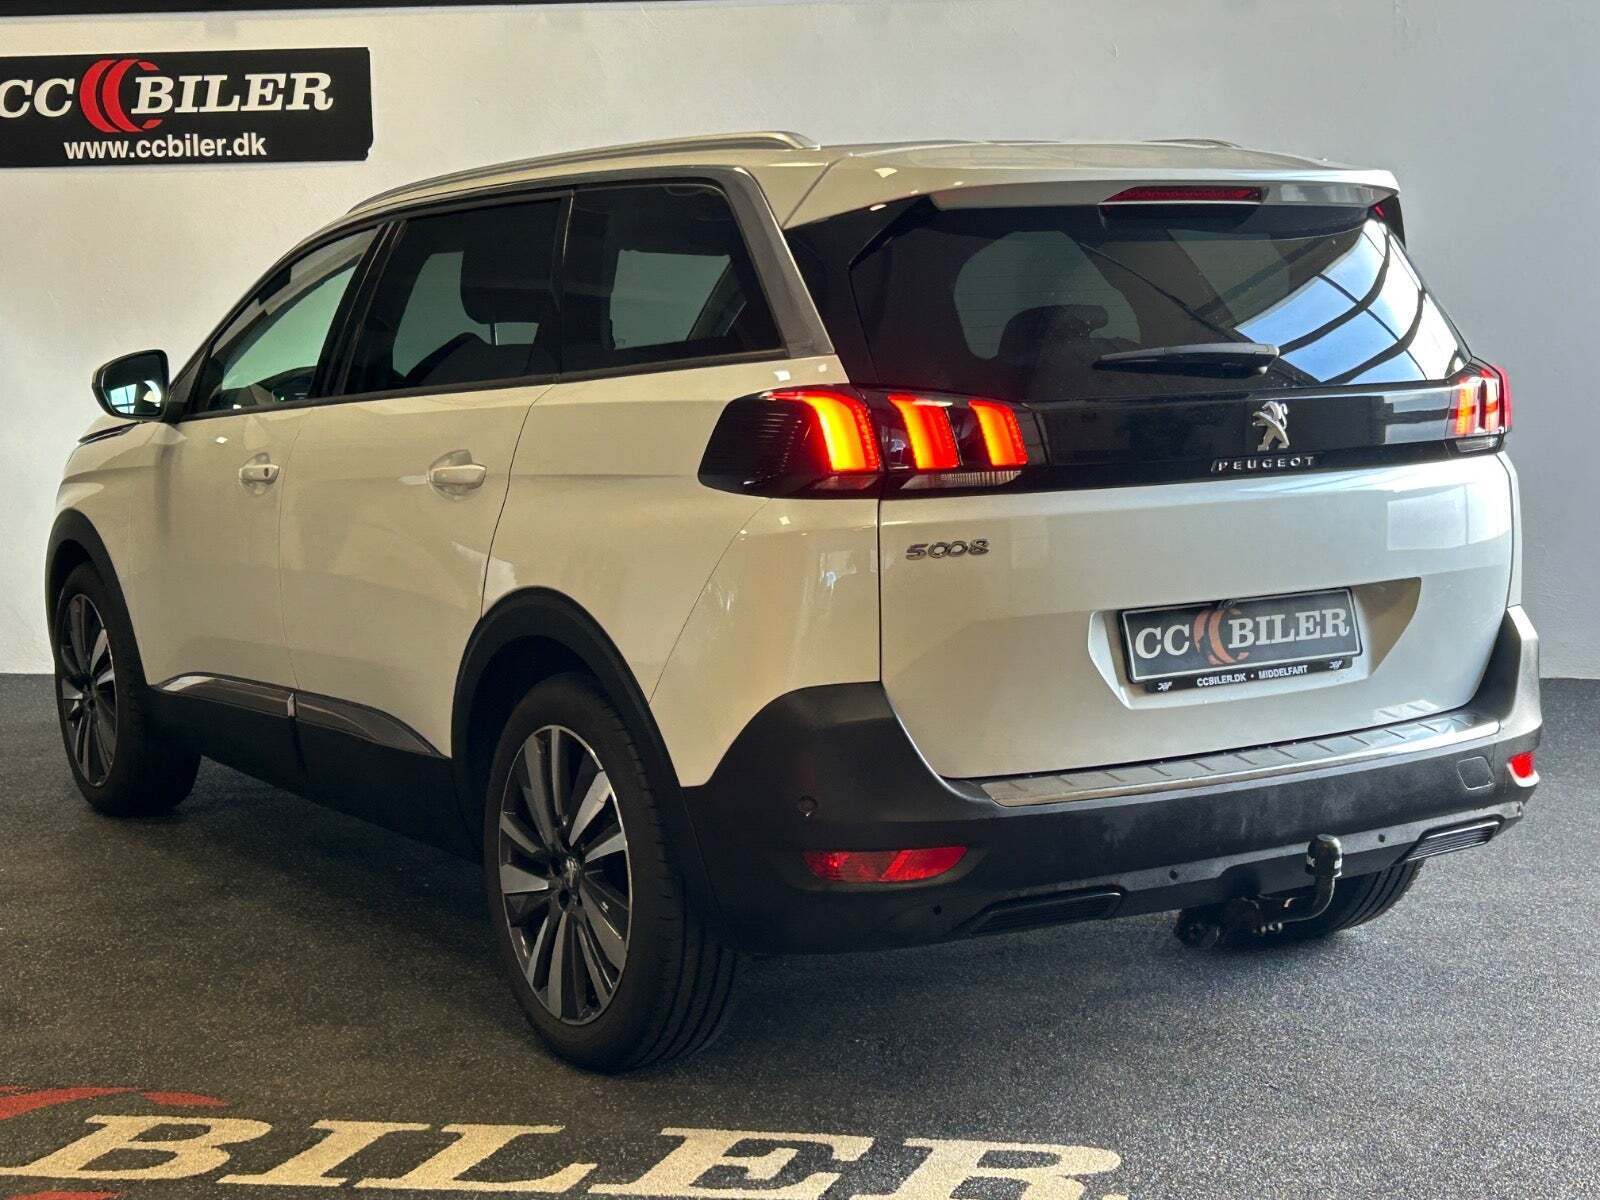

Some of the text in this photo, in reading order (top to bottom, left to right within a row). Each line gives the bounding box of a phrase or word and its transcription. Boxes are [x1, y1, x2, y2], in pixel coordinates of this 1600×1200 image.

[130, 72, 334, 115] BILER
[63, 132, 267, 159] www.ccbiler.dk
[1217, 456, 1314, 472] PEUGEOT
[905, 538, 990, 560] 5008
[1134, 608, 1350, 659] CC BILER
[1196, 664, 1308, 687] CCBILER.DK MIDDELFART
[0, 1114, 1123, 1200] BILER
